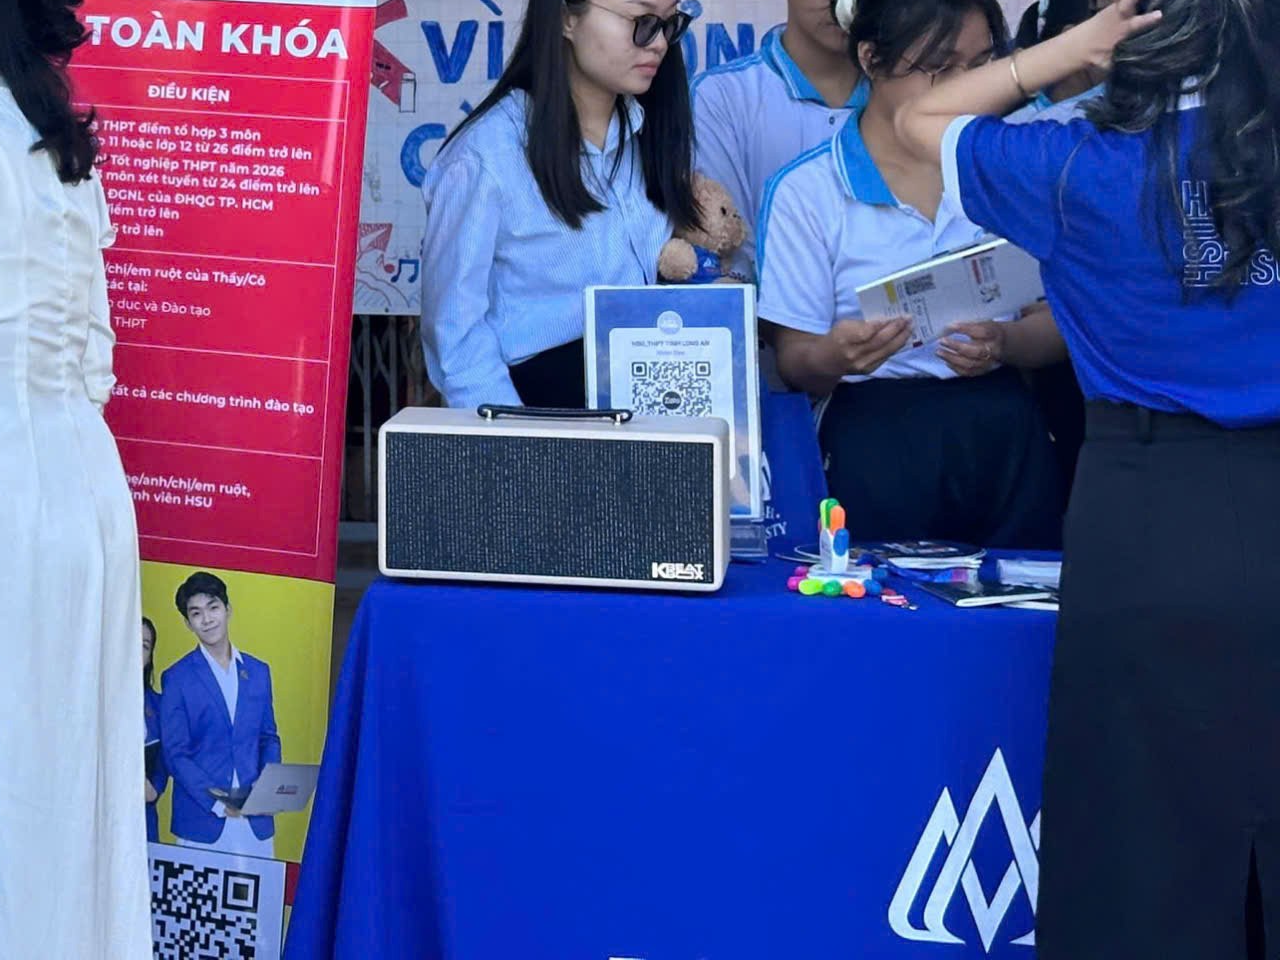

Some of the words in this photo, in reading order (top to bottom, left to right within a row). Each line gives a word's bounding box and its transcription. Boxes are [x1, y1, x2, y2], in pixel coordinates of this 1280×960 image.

[85, 10, 205, 52] TOÀN
[221, 18, 349, 61] KHÓA
[147, 81, 187, 100] ĐIỀU
[191, 85, 230, 104] KIỆN
[103, 120, 136, 132] THPT
[191, 126, 217, 141] hợp
[219, 127, 227, 139] 3
[231, 129, 261, 141] môn
[108, 135, 118, 147] 11
[122, 136, 153, 152] hoặc
[156, 138, 177, 153] lớp
[179, 140, 192, 152] 12
[195, 141, 210, 153] từ
[213, 142, 229, 154] 26
[291, 147, 312, 161] lên
[110, 153, 130, 166] Tốt
[133, 157, 179, 172] nghiệp
[183, 159, 217, 172] THPT
[220, 162, 249, 176] năm
[252, 164, 285, 177] 2026
[106, 170, 135, 182] môn
[138, 171, 159, 184] xét
[202, 176, 218, 189] từ
[220, 179, 236, 191] 24
[299, 183, 320, 197] lên
[107, 188, 144, 202] ĐGNL
[147, 190, 171, 203] của
[174, 193, 215, 208] ĐHQG
[242, 198, 273, 211] HCM
[137, 205, 157, 218] trở
[159, 207, 180, 220] lên
[143, 225, 164, 237] lên
[154, 267, 182, 282] ruột
[185, 269, 209, 282] của
[161, 301, 187, 314] Đào
[190, 305, 211, 318] tạo
[113, 315, 148, 329] THPT
[131, 385, 147, 398] cả
[150, 387, 174, 401] các
[176, 392, 226, 408] chương
[228, 395, 262, 410] trình
[264, 397, 290, 412] đào
[293, 400, 315, 415] tạo
[153, 490, 181, 505] viên
[184, 494, 213, 508] HSU
